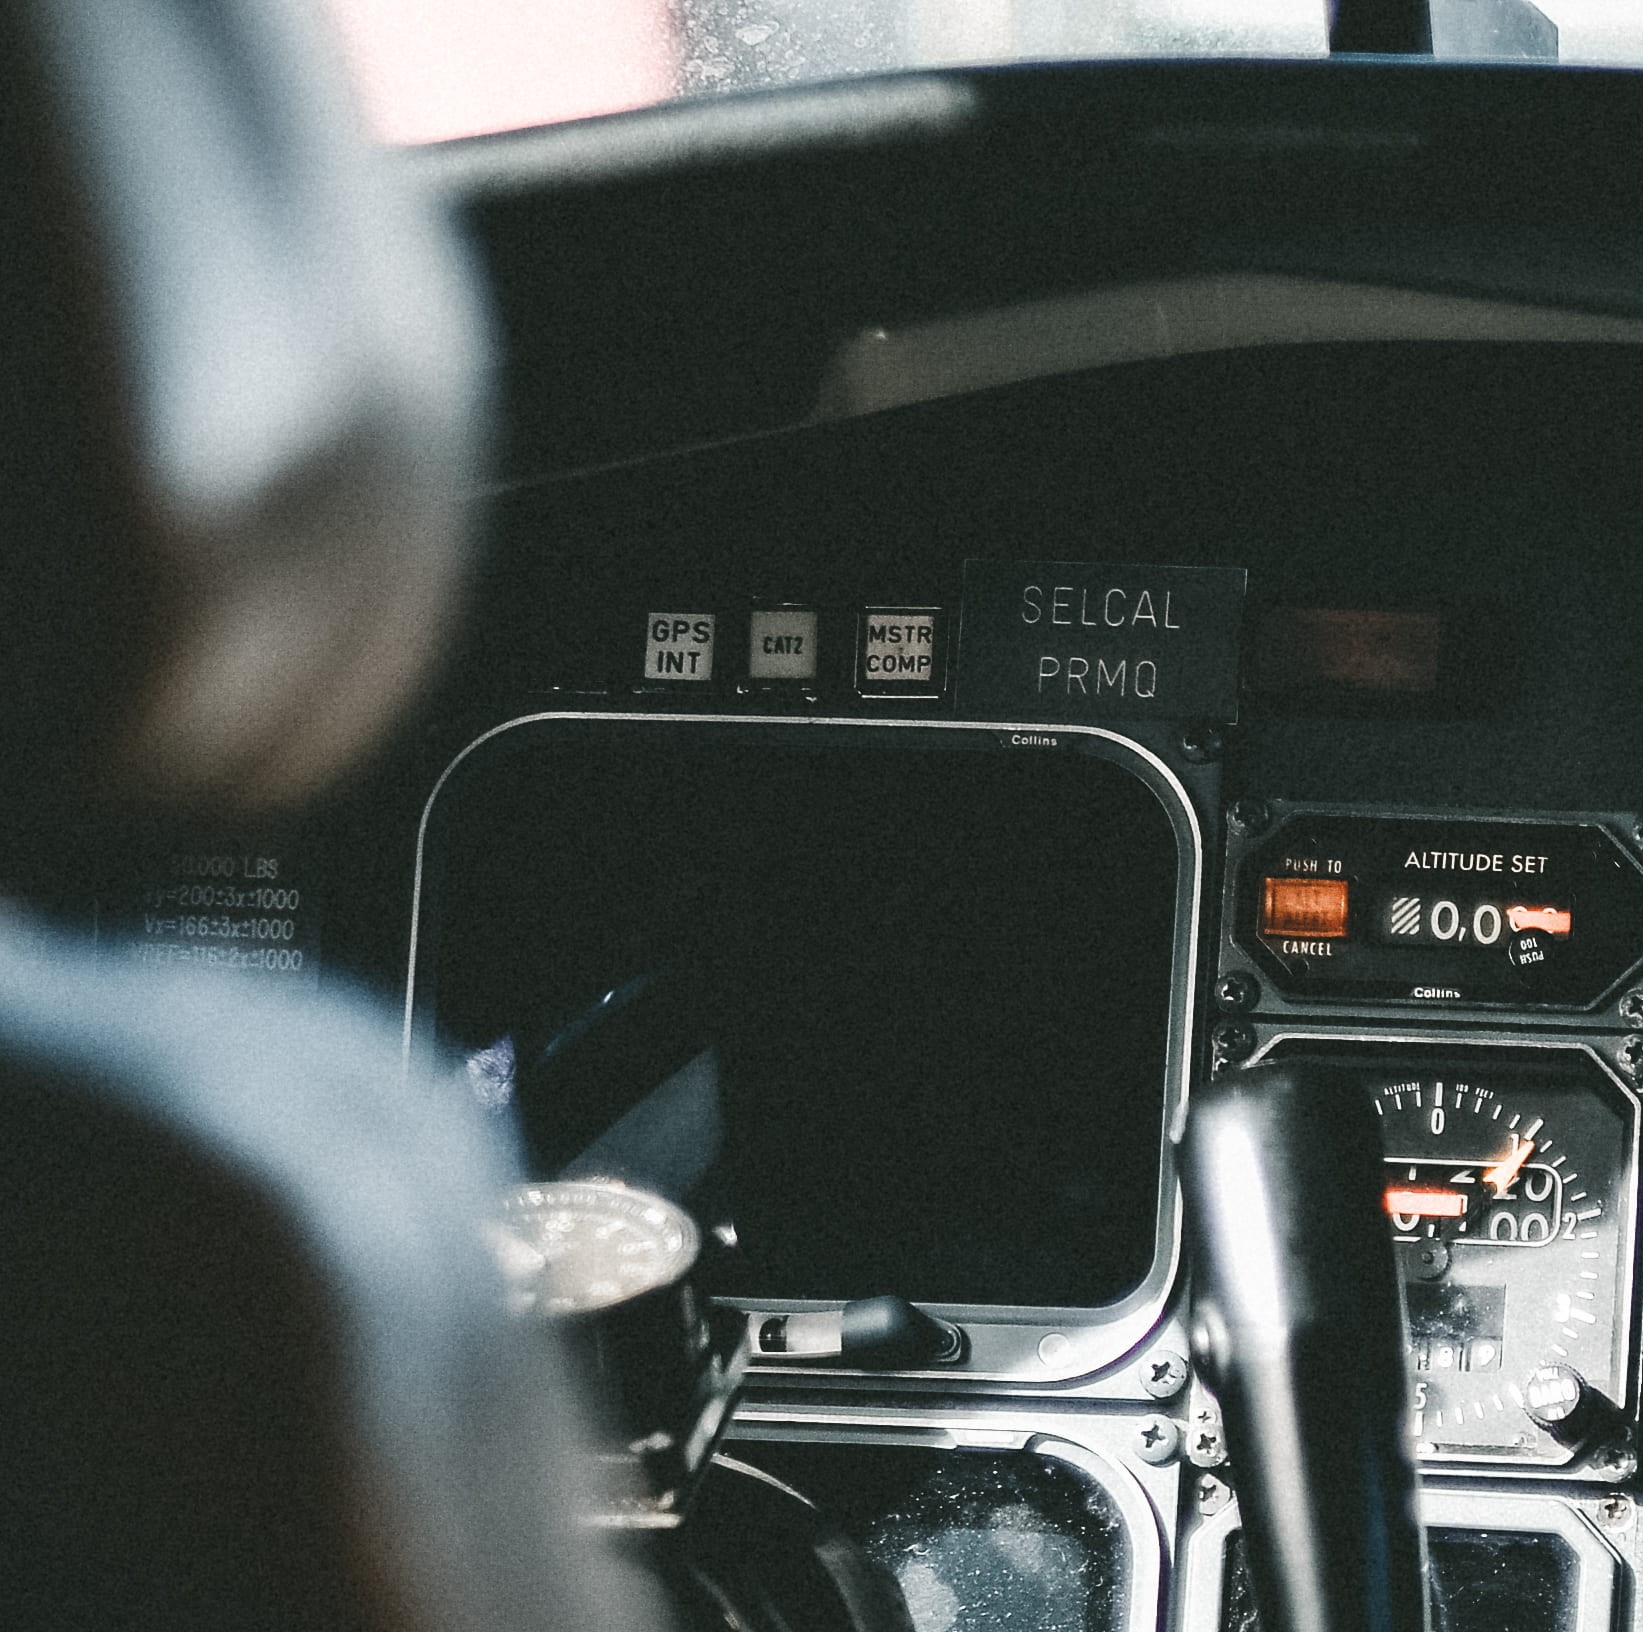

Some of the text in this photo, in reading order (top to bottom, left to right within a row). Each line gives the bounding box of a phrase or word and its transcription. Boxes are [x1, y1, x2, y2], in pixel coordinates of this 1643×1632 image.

[1021, 588, 1180, 630] SELCAL
[652, 621, 711, 643] GPS
[869, 624, 932, 644] MSTR
[657, 652, 700, 674] INT
[866, 654, 931, 673] COMP
[1039, 658, 1158, 699] PRMQ
[1011, 734, 1057, 746] Collins
[1286, 858, 1341, 874] PUSH TO
[1404, 851, 1548, 874] ALTITUDE SET
[1283, 940, 1332, 956] CANCEL
[1414, 987, 1461, 998] Collins
